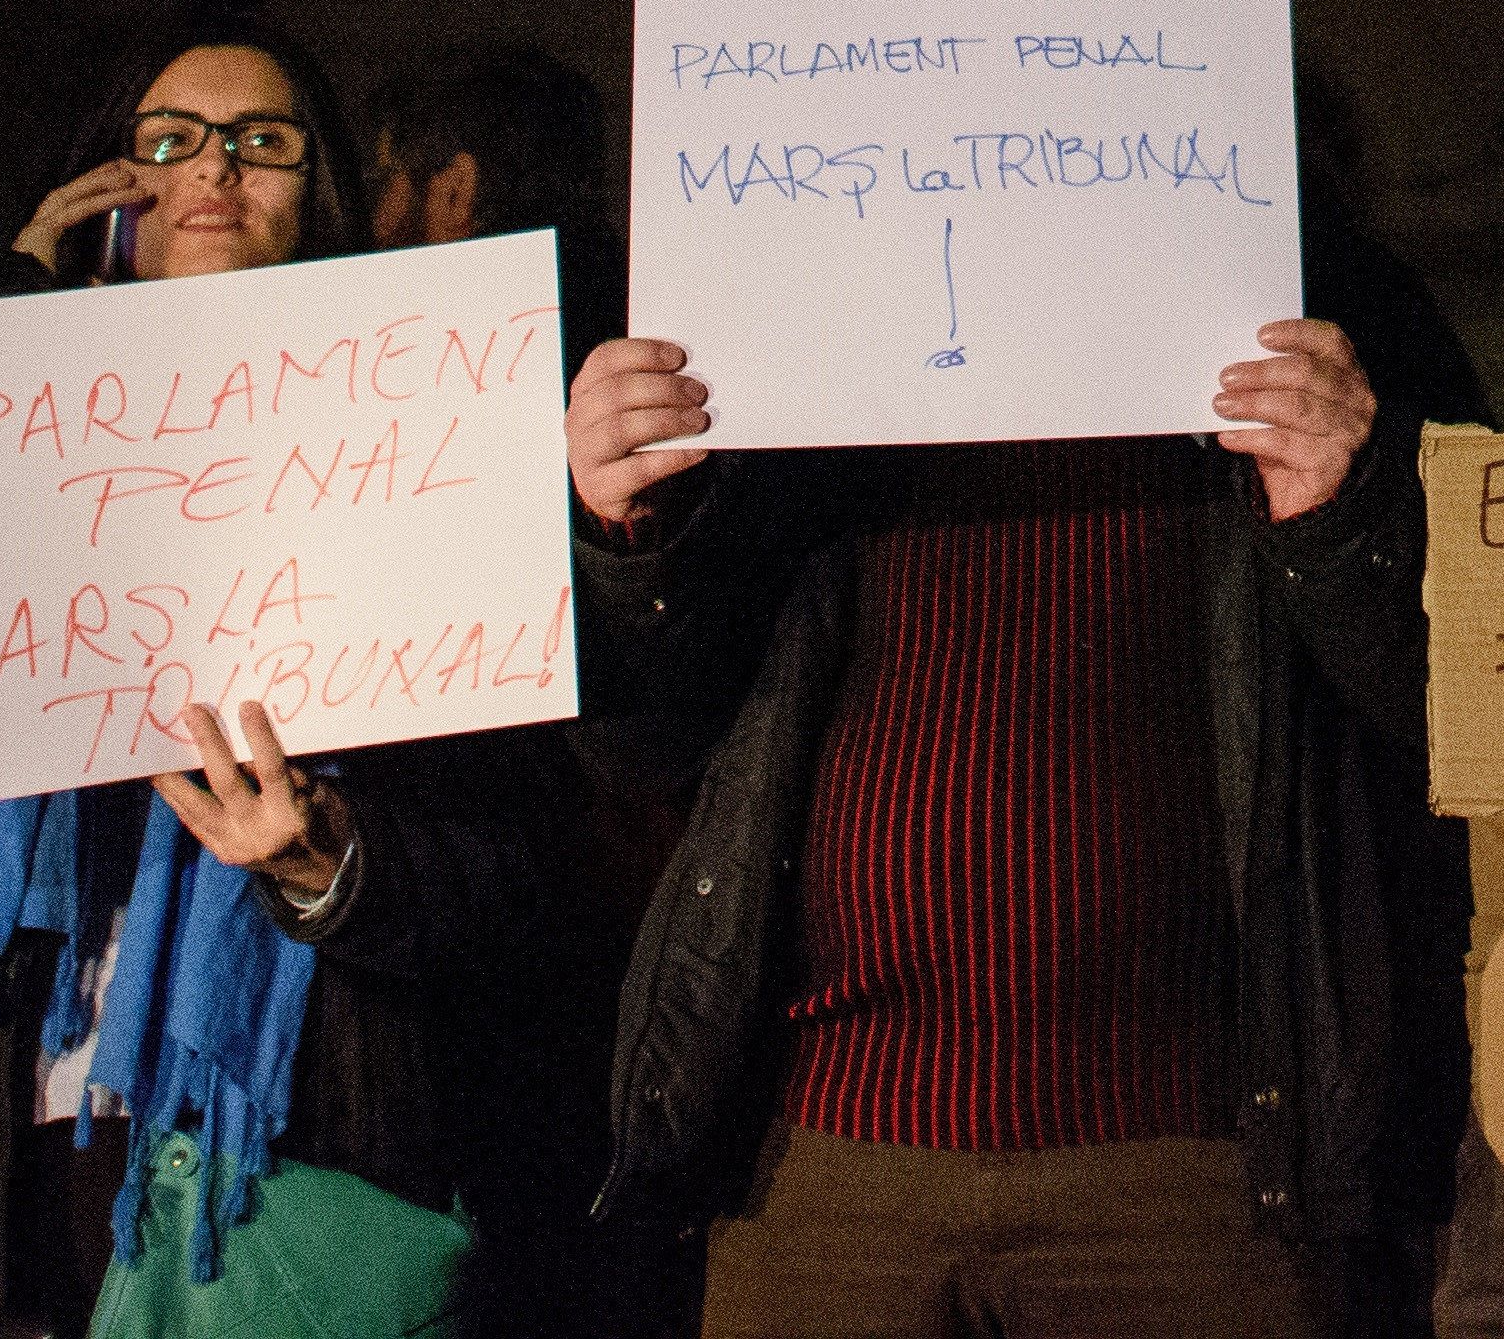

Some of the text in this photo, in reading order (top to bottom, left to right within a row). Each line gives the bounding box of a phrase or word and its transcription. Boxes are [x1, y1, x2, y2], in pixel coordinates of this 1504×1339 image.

[670, 30, 1207, 89] PARLAMENT PENAL
[953, 127, 1273, 207] TRIBUNAL
[58, 416, 478, 548] PENAL
